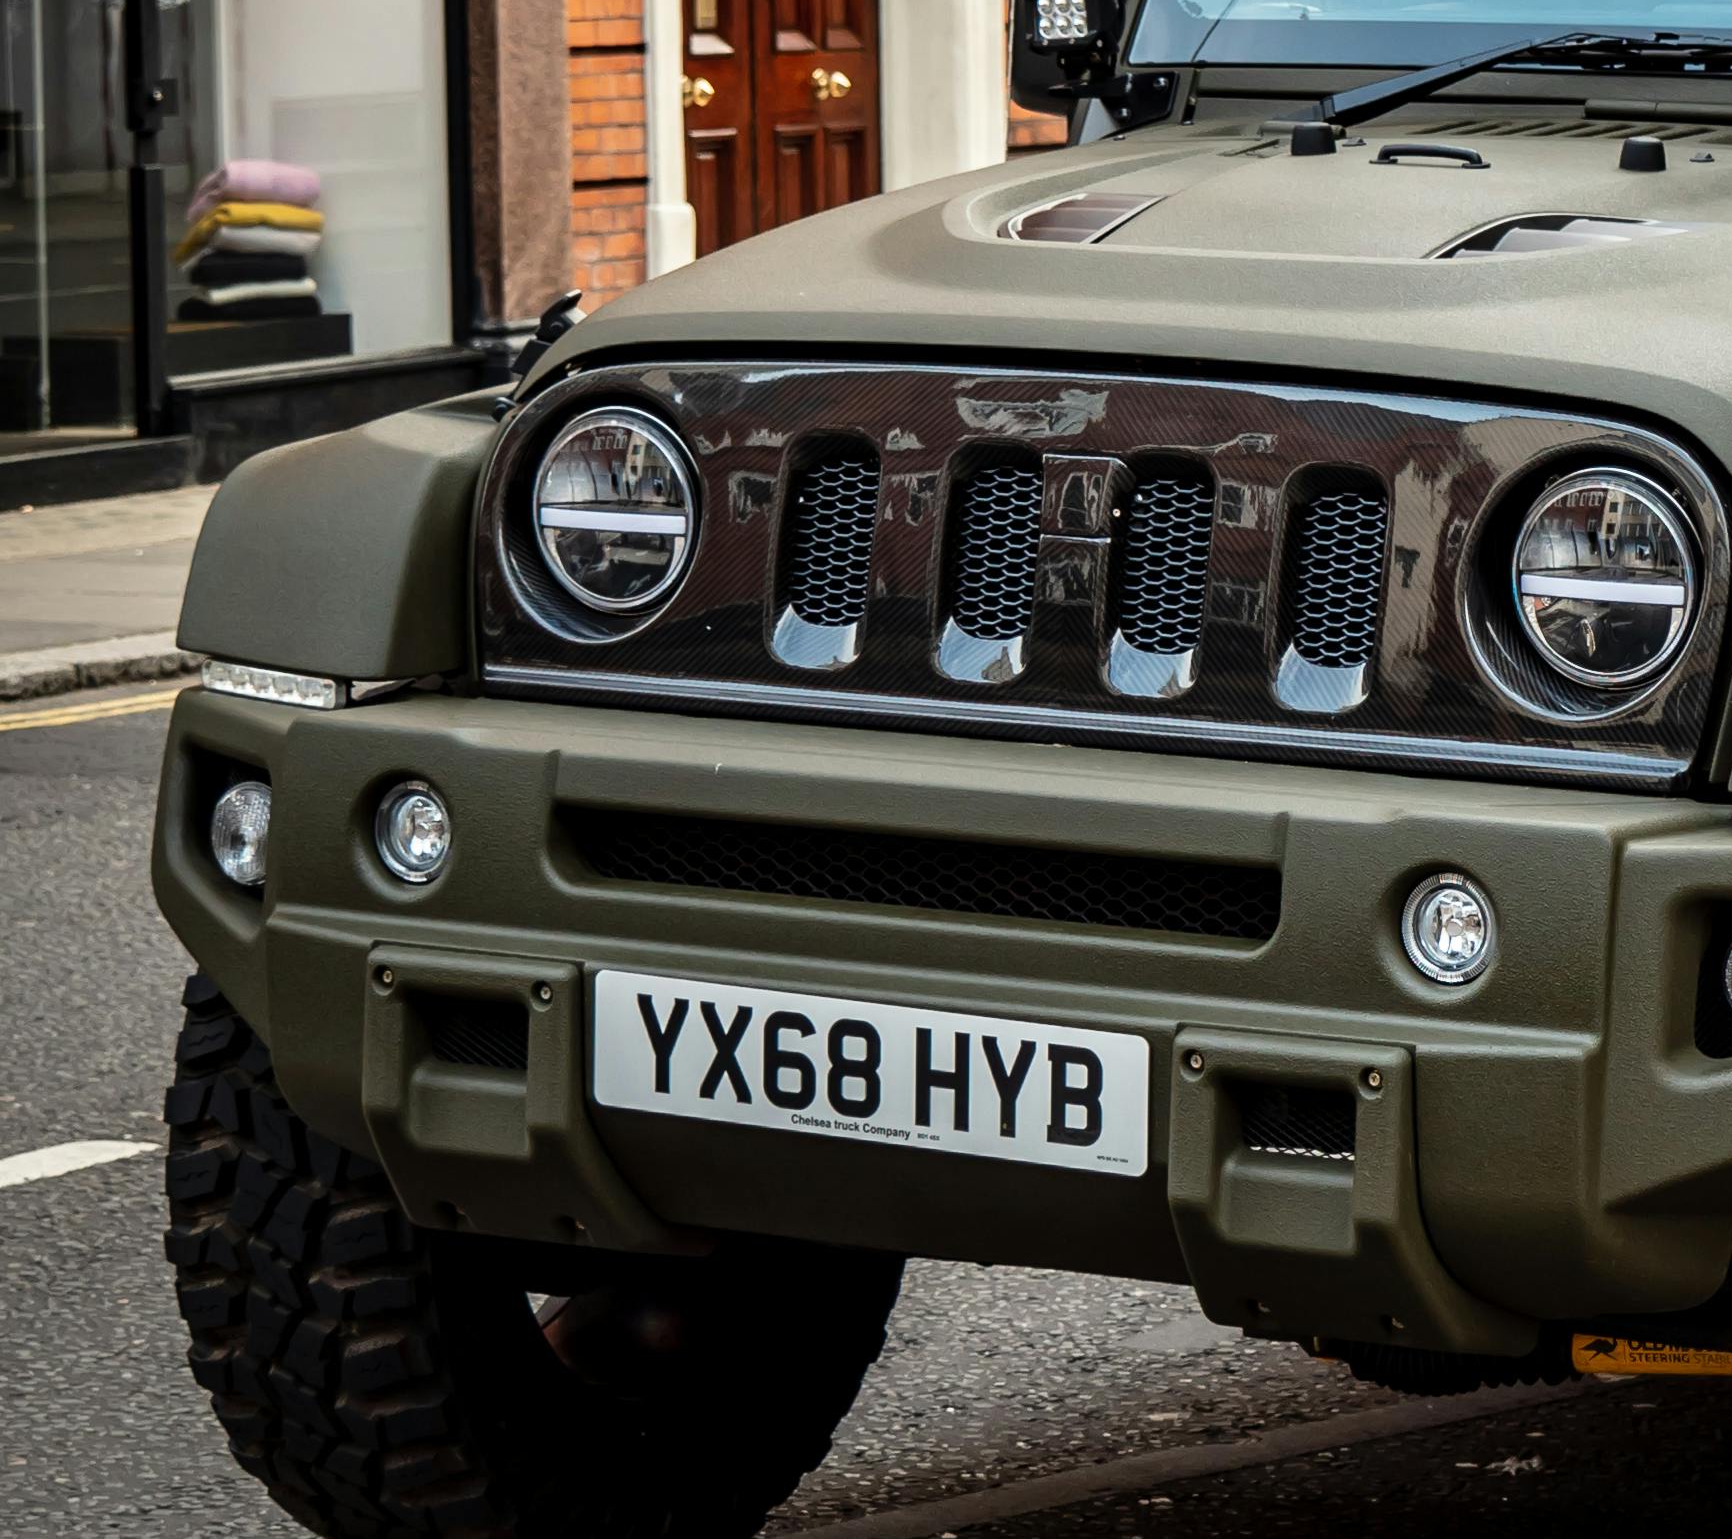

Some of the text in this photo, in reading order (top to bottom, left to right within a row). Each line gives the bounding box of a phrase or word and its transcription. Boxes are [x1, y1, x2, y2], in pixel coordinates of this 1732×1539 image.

[637, 993, 1104, 1148] YX68 HYB
[790, 1113, 832, 1129] Chelsea
[834, 1120, 860, 1132] truck
[862, 1123, 911, 1141] Company
